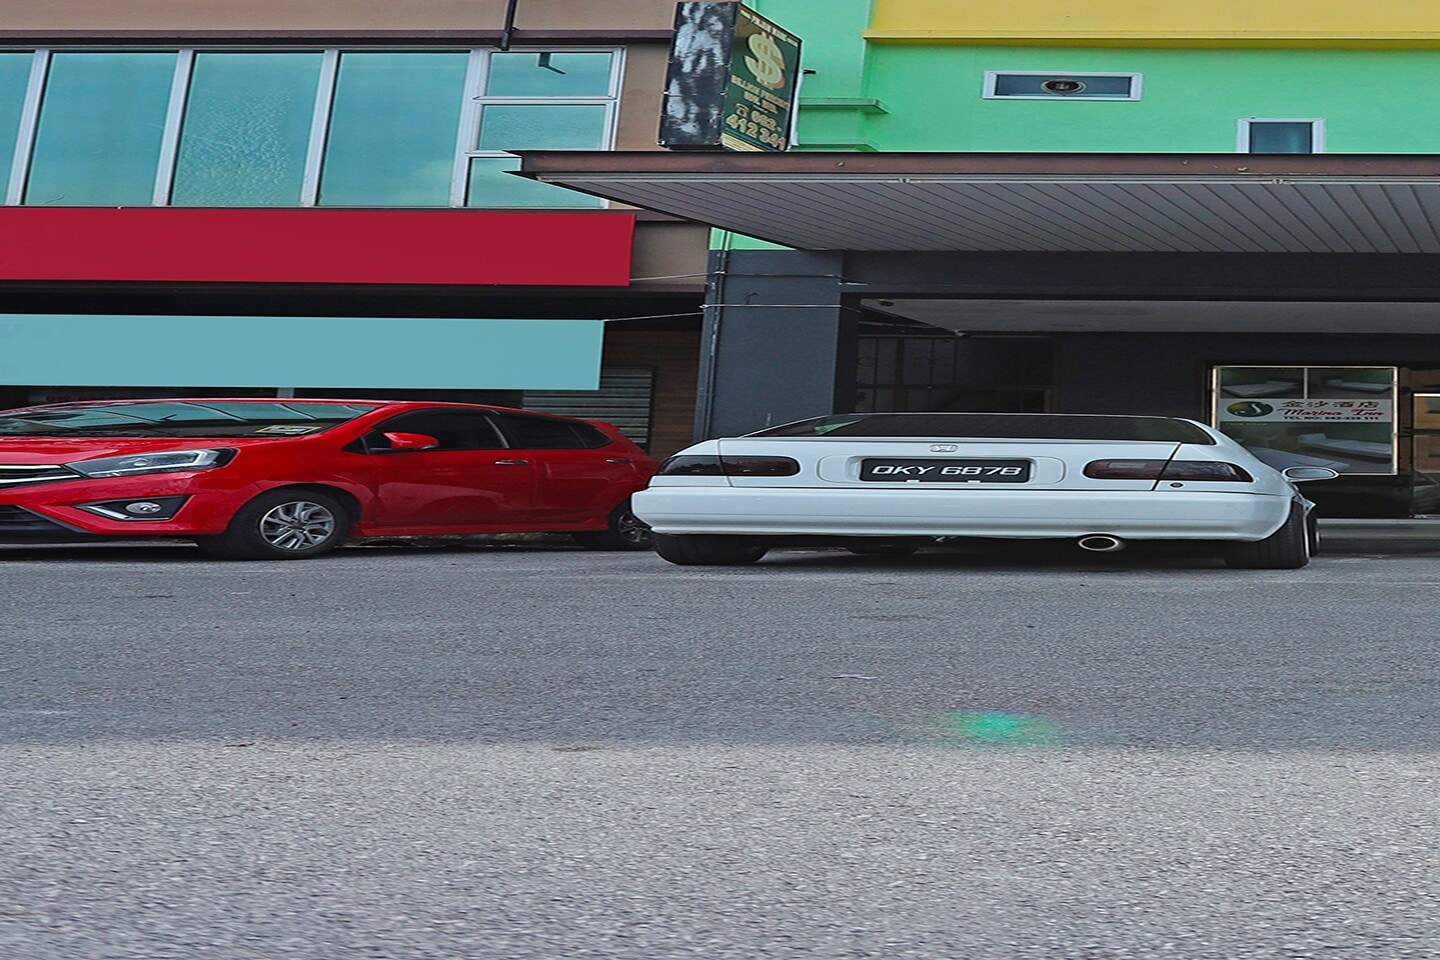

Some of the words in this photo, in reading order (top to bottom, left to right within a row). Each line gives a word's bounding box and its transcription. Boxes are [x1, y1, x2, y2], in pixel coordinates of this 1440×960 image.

[1277, 408, 1343, 416] Marina
[1350, 408, 1384, 416] Inn
[871, 465, 936, 476] QKY
[941, 466, 1023, 476] 6878
